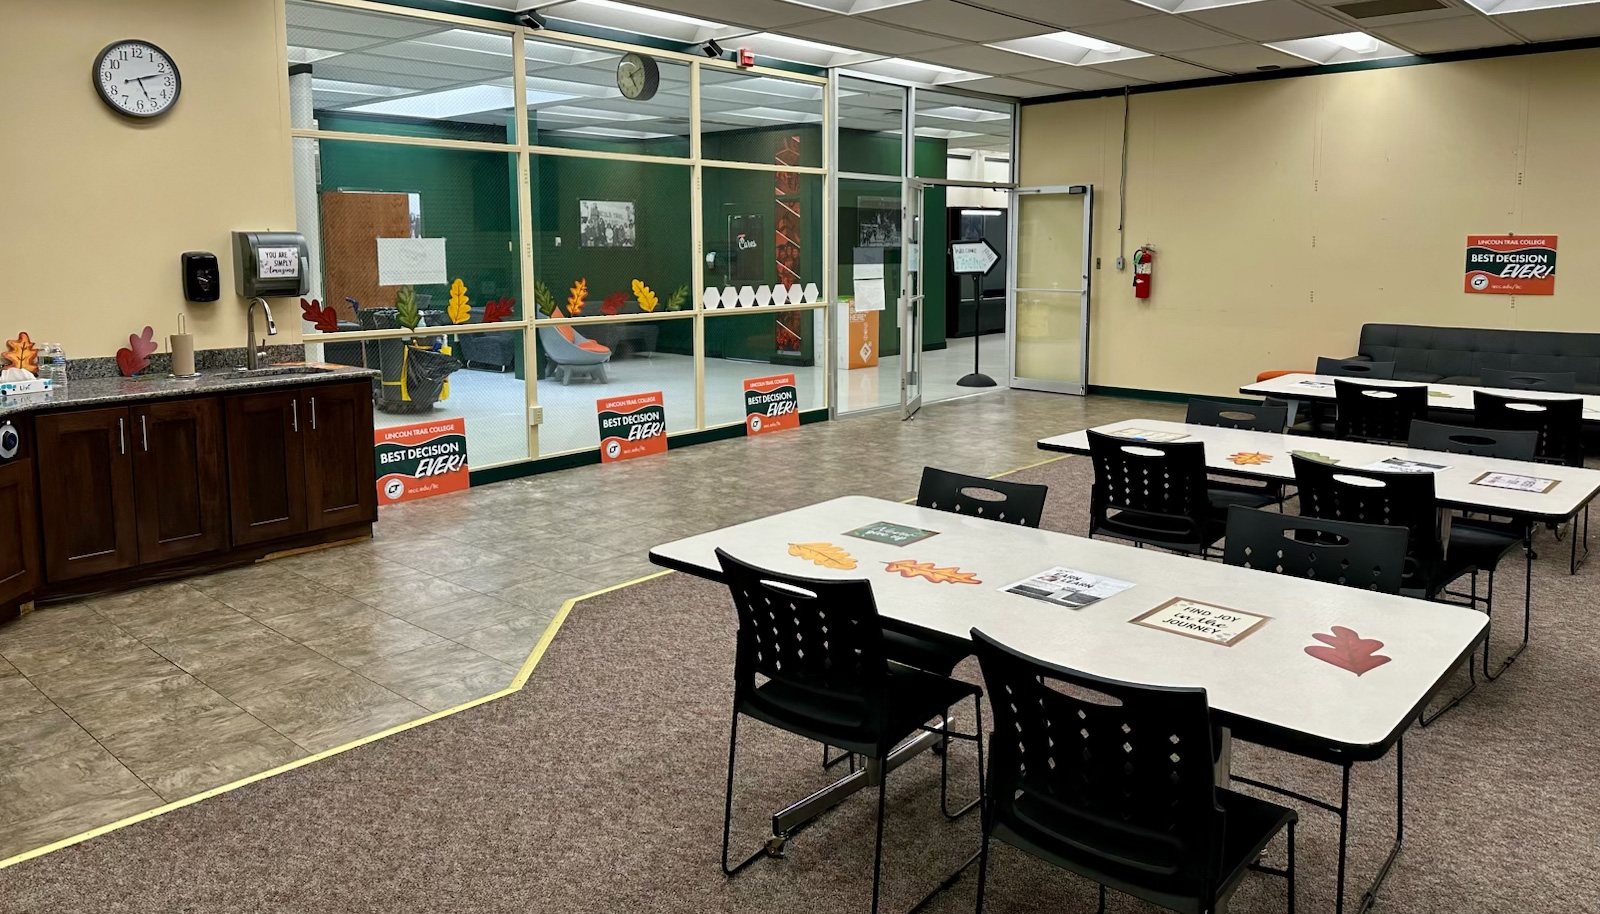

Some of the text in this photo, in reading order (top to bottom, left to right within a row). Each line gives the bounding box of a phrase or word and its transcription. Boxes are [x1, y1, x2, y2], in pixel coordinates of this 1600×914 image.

[119, 50, 128, 61] 11
[132, 48, 143, 58] 12
[149, 53, 154, 62] 1
[109, 59, 120, 69] 10
[158, 63, 165, 73] 2
[104, 71, 112, 81] 9
[164, 76, 171, 86] 3
[110, 85, 118, 95] 8
[160, 89, 166, 99] 4
[122, 95, 129, 105] 7
[137, 100, 144, 110] 6
[150, 98, 157, 107] 5
[1471, 254, 1547, 263] BEST DECISION
[1500, 263, 1554, 279] EVER!
[748, 391, 792, 405] BEST DECISION
[767, 400, 796, 417] EVER!
[603, 411, 660, 428] BEST DECISION
[385, 424, 455, 440] LINCOLN TRAIL COLLEGE
[628, 422, 664, 441] EVER!
[380, 442, 459, 464] BEST DECISION
[414, 454, 466, 478] EVER!
[1054, 573, 1082, 581] EARN
[1184, 606, 1241, 622] FIND JOY
[1174, 612, 1228, 628] in the
[1162, 618, 1222, 635] JOURNEY
